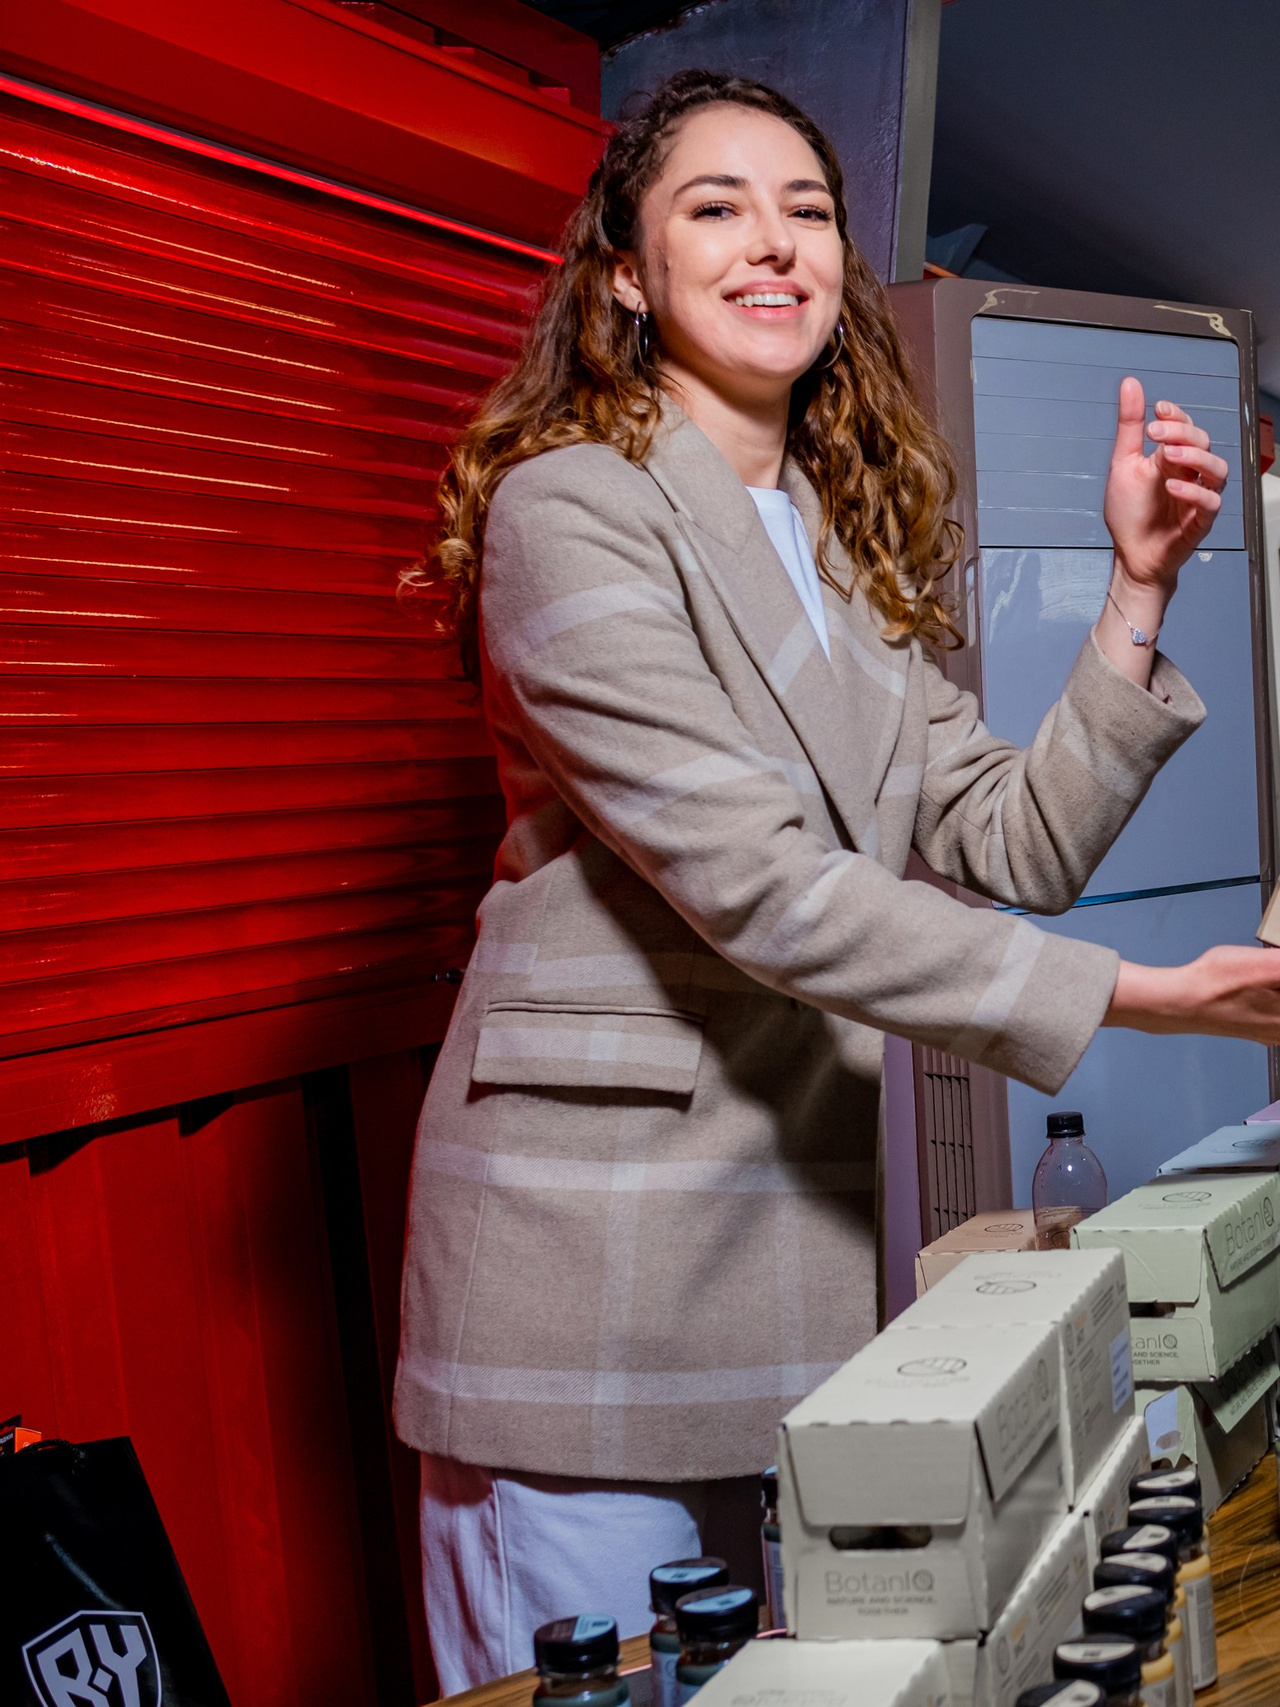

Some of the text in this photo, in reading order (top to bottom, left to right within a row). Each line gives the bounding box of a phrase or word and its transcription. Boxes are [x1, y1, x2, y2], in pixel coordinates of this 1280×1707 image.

[1224, 1195, 1276, 1257] BotanIQ
[1132, 1333, 1178, 1350] anIQ
[1133, 1351, 1148, 1359] AND
[824, 1568, 936, 1595] BotanIQ
